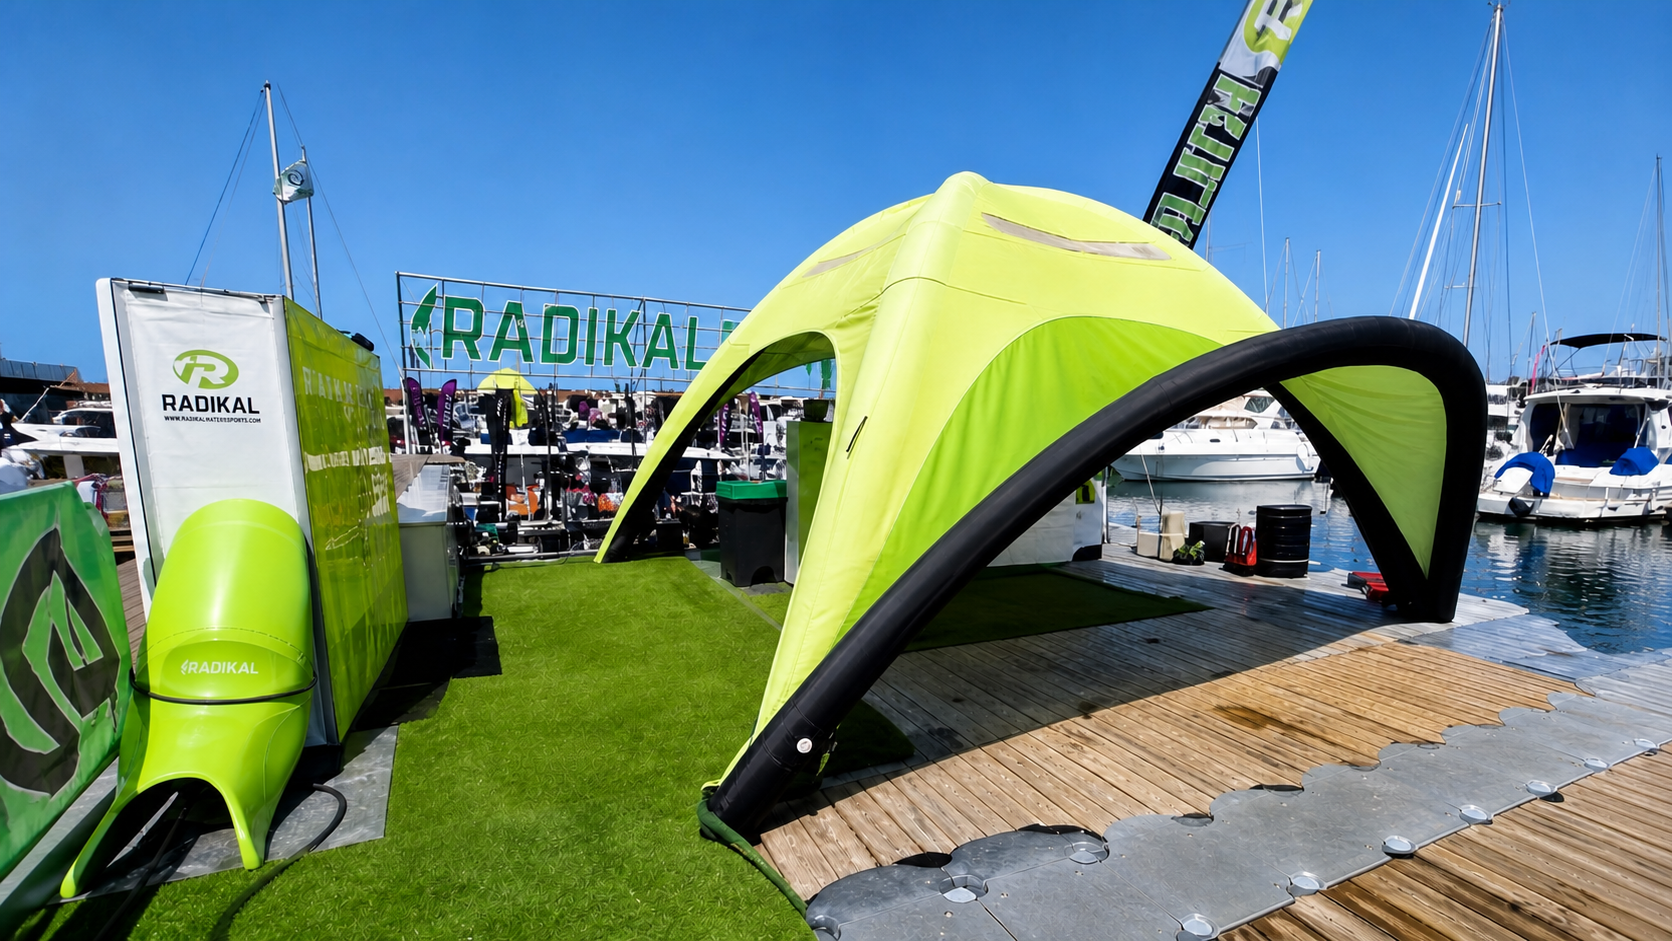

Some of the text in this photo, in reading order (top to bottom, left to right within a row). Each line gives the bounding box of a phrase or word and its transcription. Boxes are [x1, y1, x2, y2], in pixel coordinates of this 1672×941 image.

[441, 294, 709, 371] RADIKAL
[162, 394, 260, 414] RADIKAL
[187, 661, 259, 674] RADIKAL
